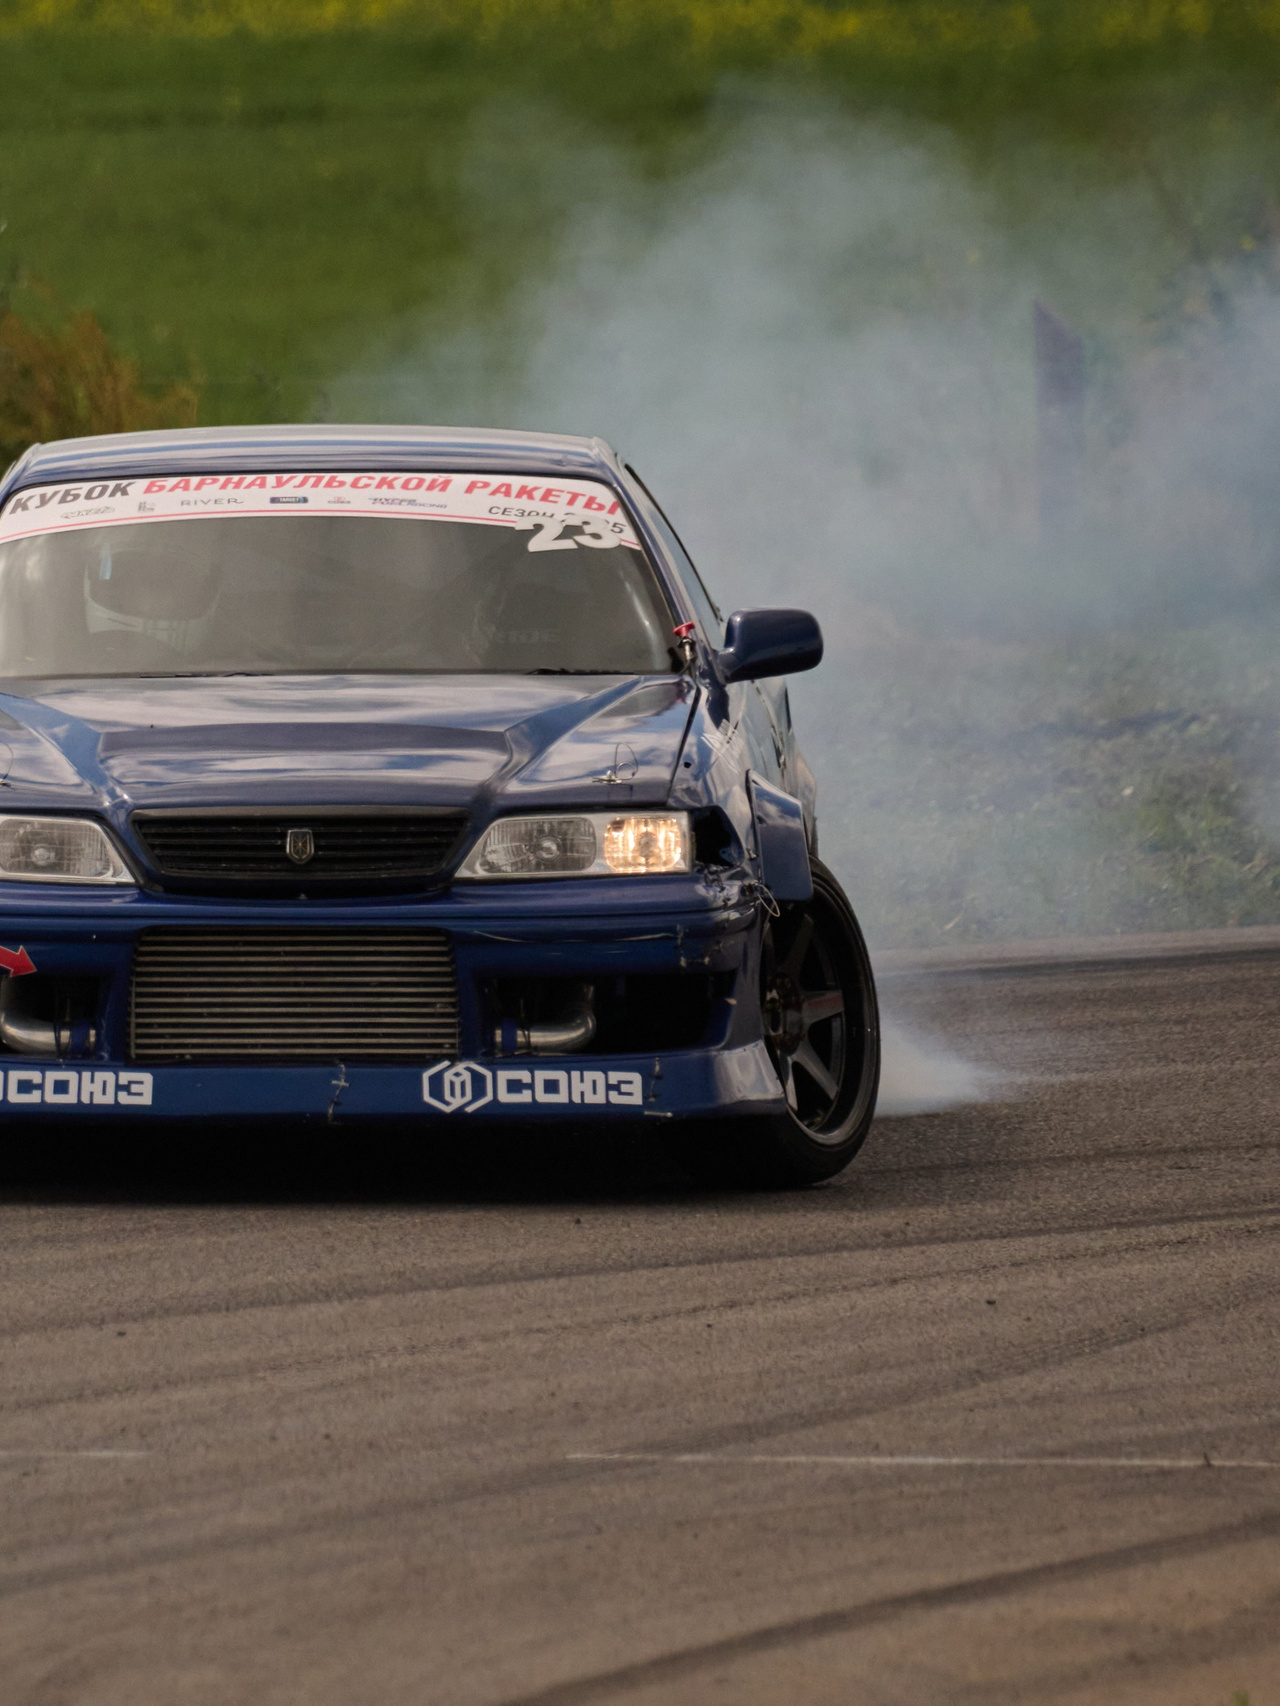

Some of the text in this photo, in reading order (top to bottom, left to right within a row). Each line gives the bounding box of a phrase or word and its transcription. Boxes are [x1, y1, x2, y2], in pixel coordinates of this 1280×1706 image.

[9, 481, 136, 515] КУБОК
[142, 475, 453, 494] БАРНАУЛЬСКОЙ
[464, 480, 620, 516] РАКЕТЫ
[180, 497, 244, 507] RIVER
[515, 514, 621, 552] 23
[7, 1070, 153, 1105] СОЮЗ
[497, 1070, 643, 1105] СОЮЗ
